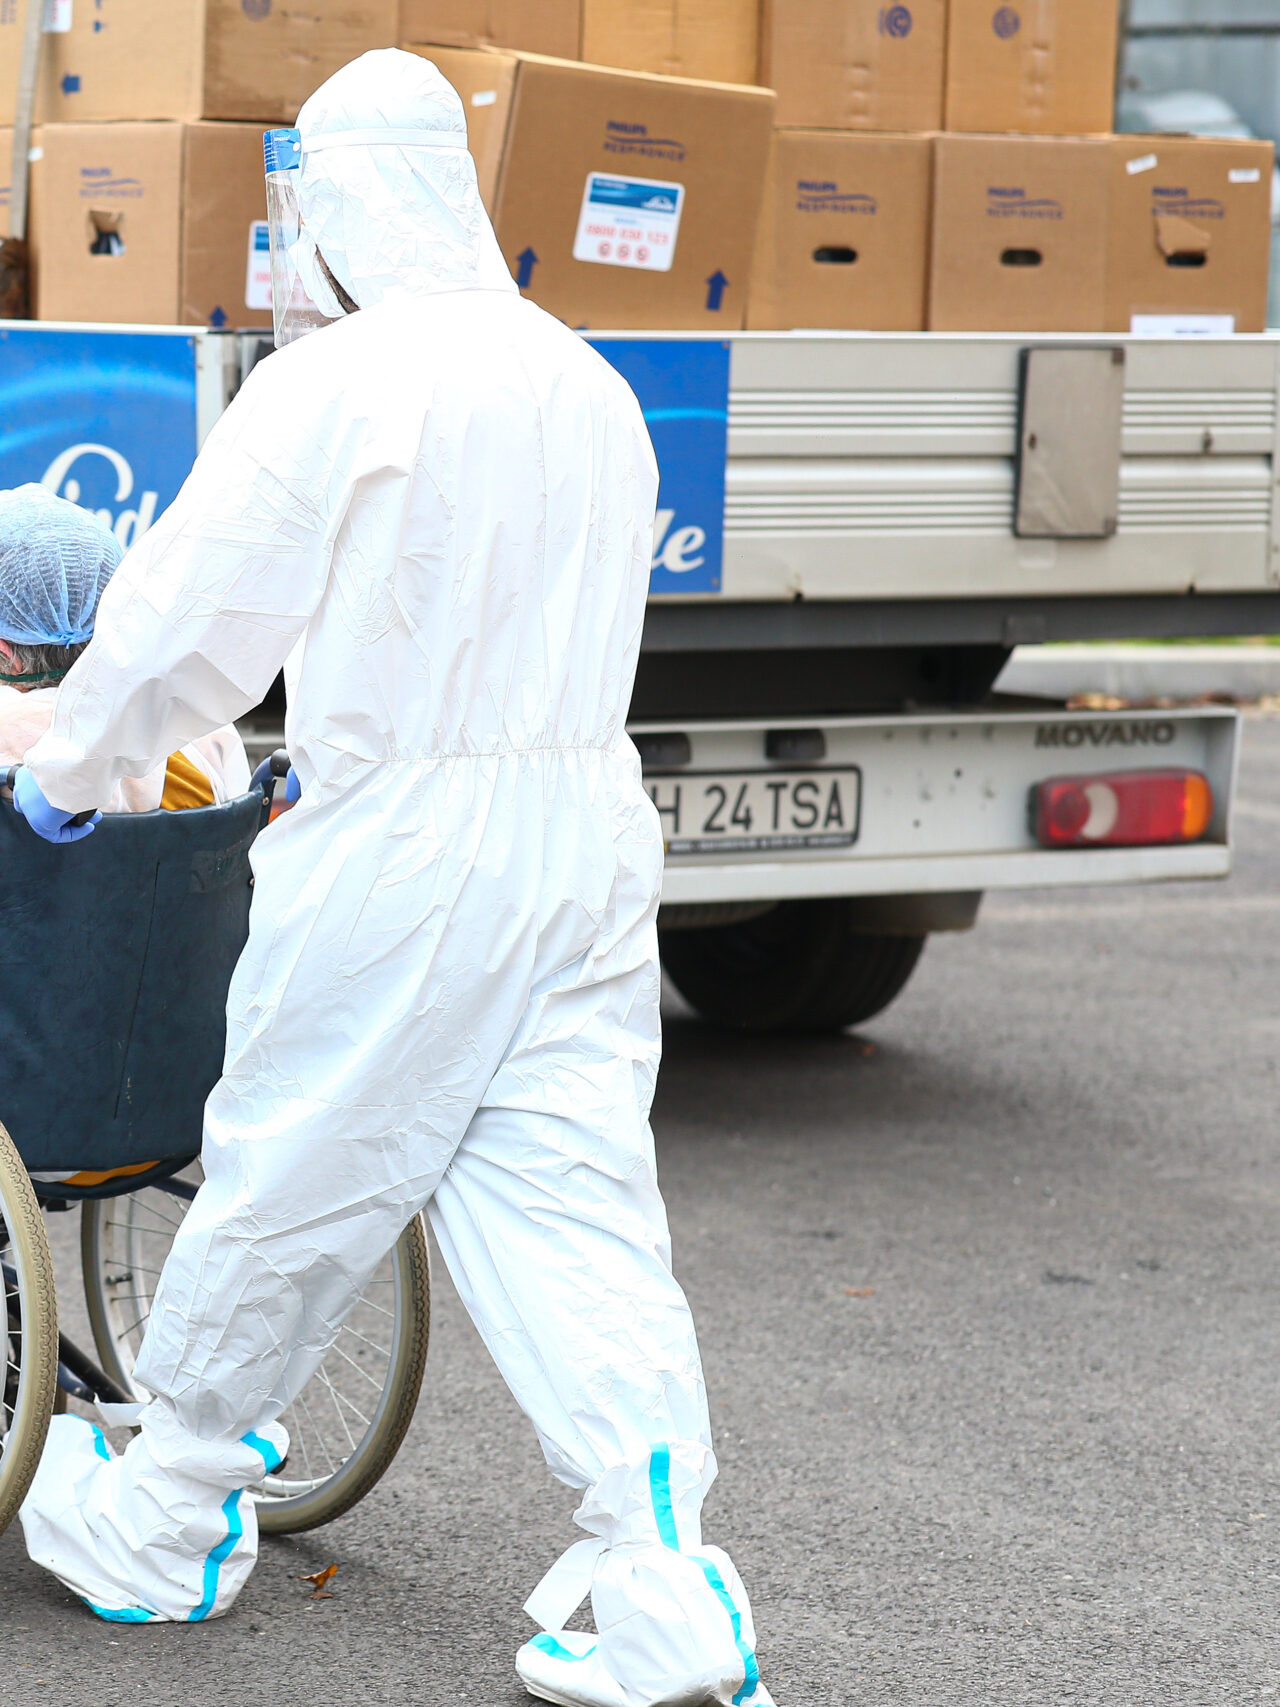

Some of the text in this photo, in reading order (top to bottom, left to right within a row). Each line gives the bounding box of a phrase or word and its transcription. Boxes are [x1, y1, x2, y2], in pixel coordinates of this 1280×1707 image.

[1034, 721, 1176, 748] MOVANO
[703, 782, 752, 833] 24
[766, 779, 845, 831] TSA
